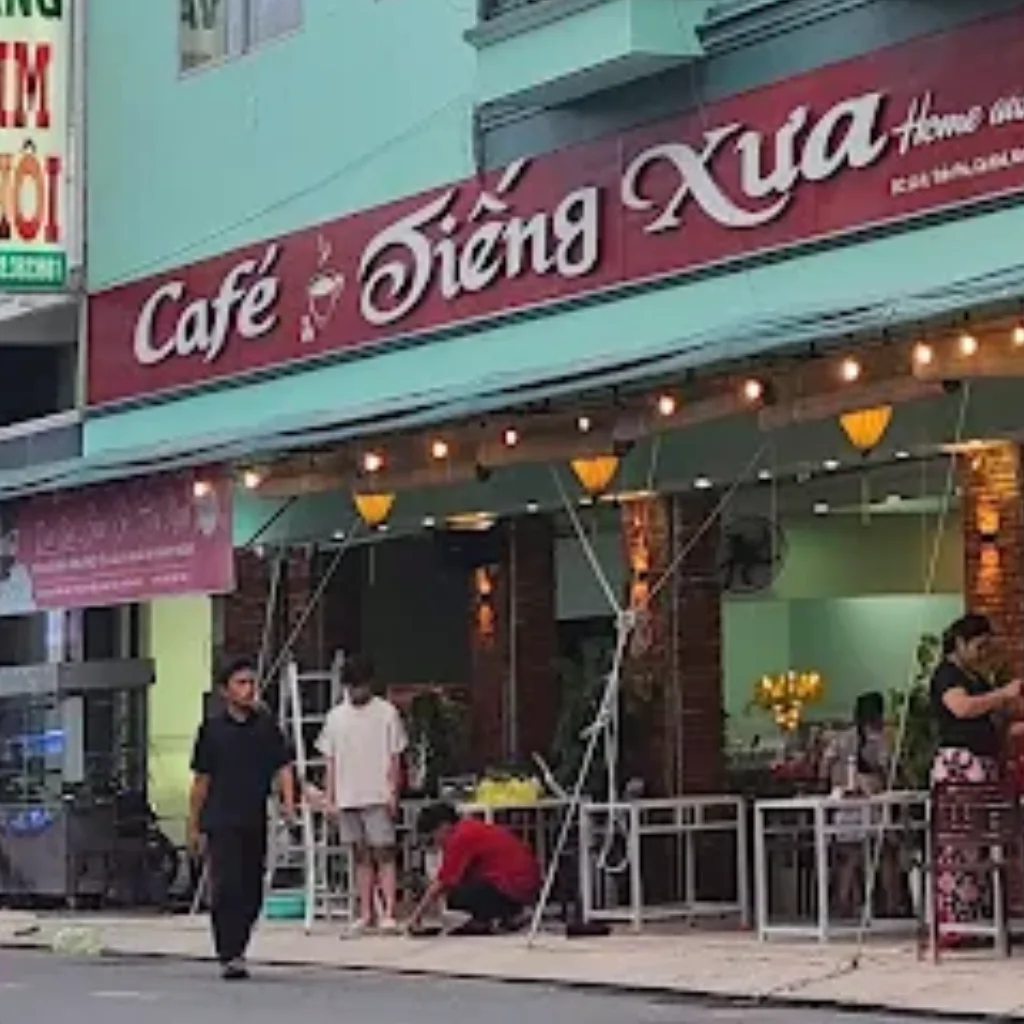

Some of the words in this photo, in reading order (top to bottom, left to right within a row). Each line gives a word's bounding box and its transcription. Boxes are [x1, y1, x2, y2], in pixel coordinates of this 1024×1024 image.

[891, 90, 983, 155] Home
[134, 243, 281, 365] Café
[359, 156, 599, 325] Tiếng
[621, 91, 889, 234] Xưa
